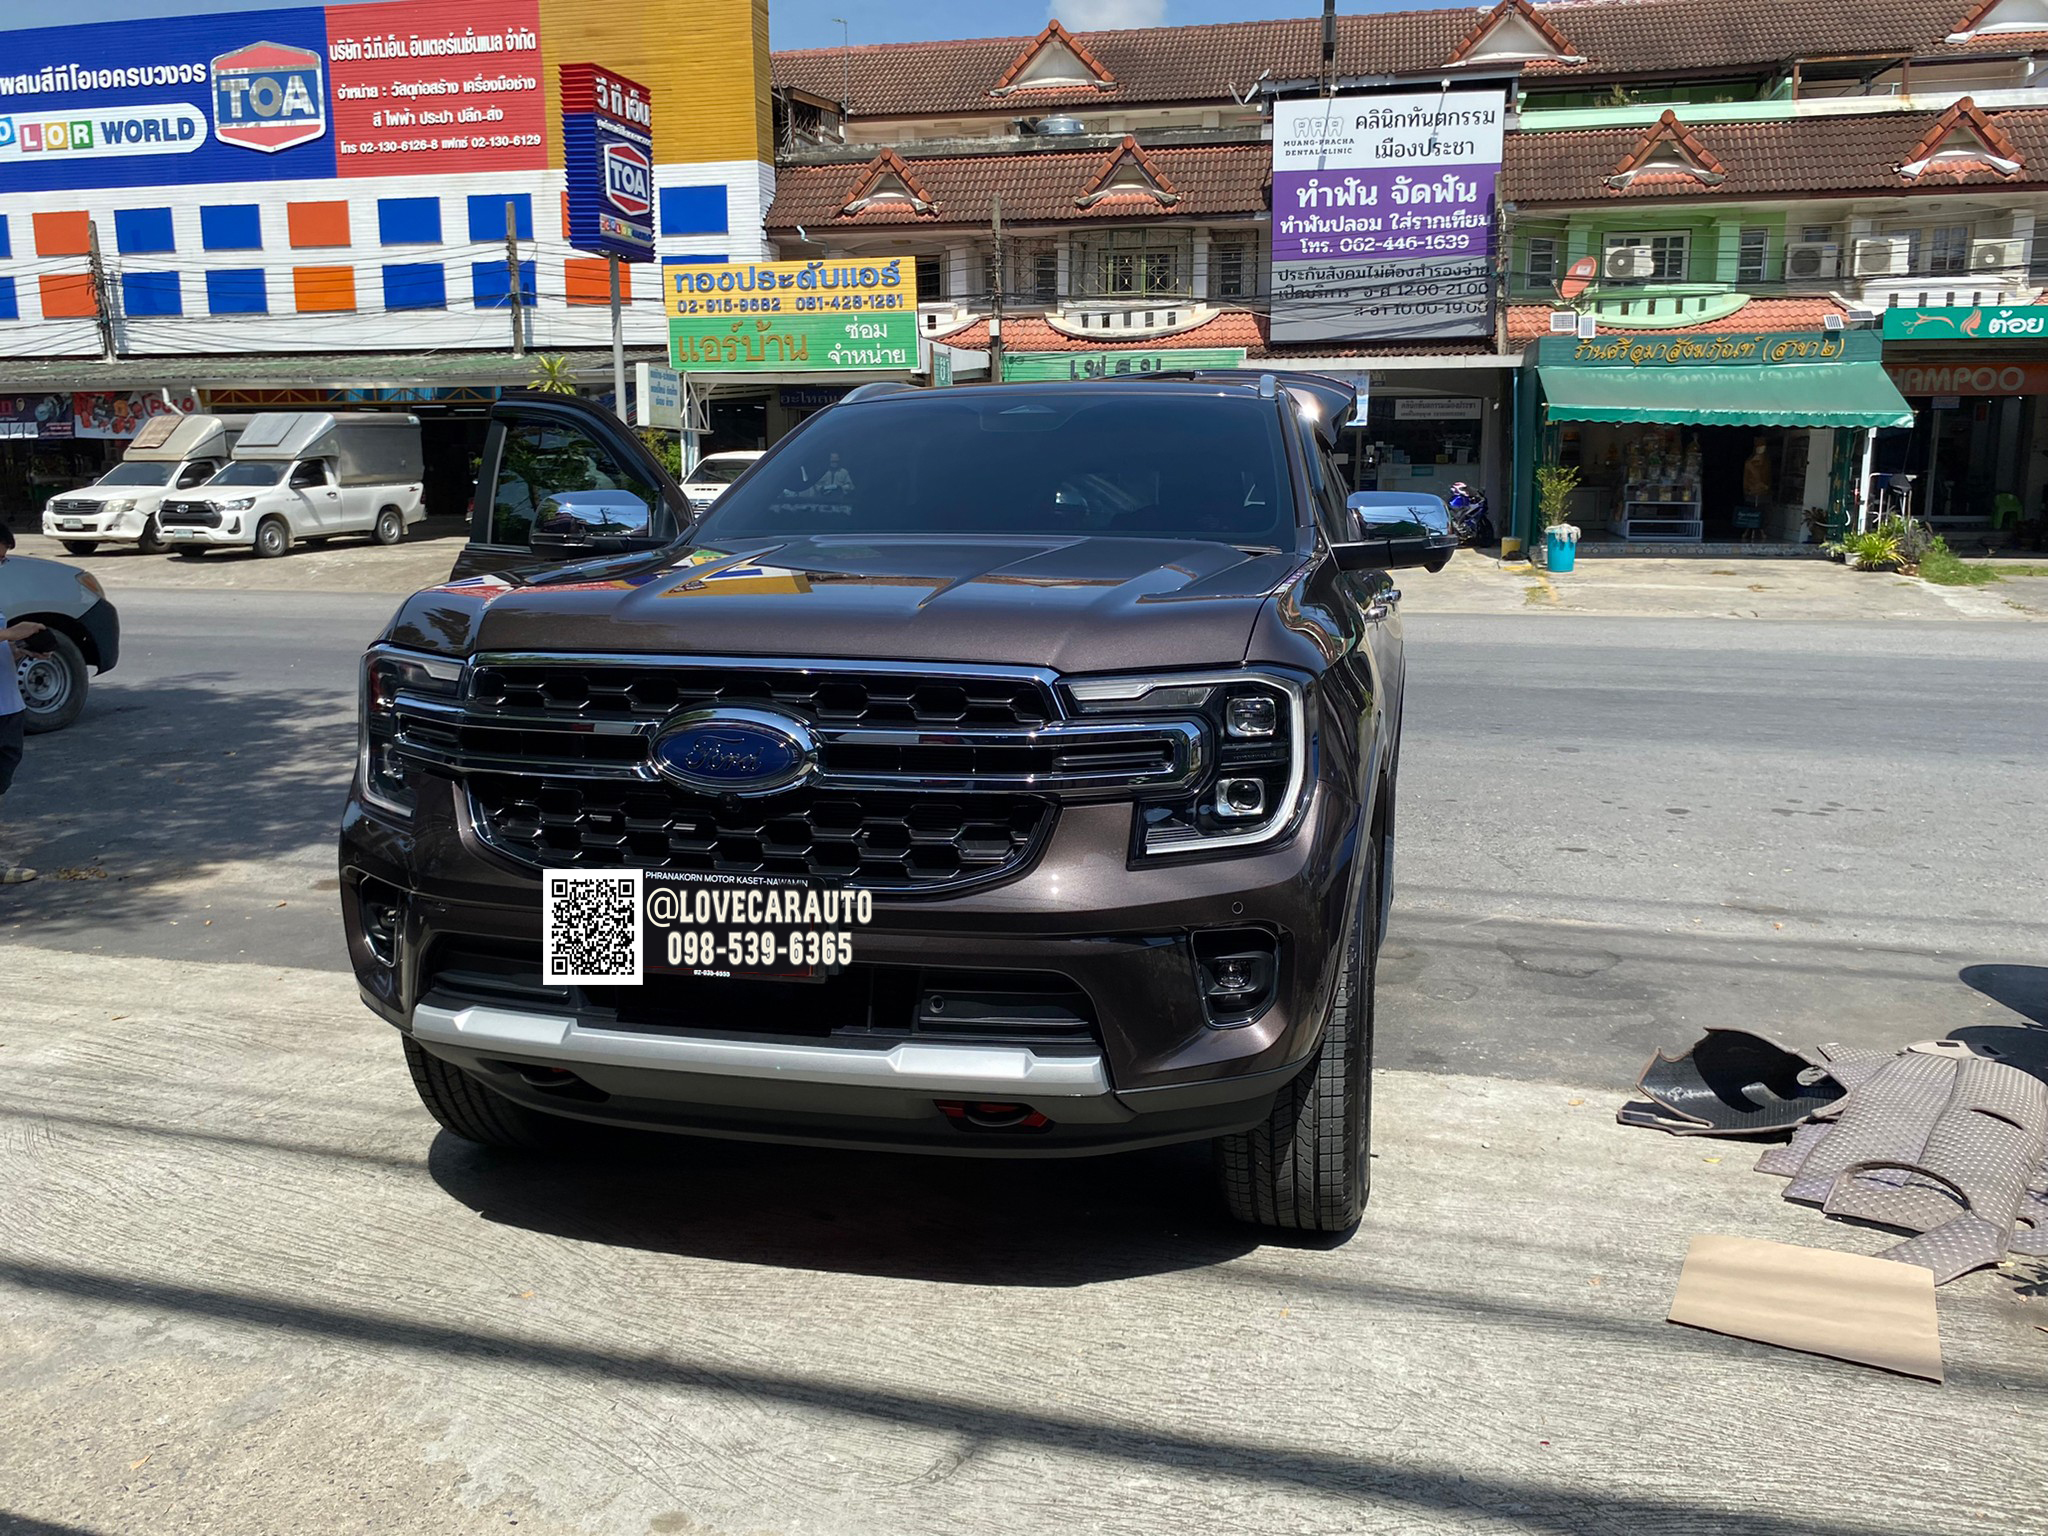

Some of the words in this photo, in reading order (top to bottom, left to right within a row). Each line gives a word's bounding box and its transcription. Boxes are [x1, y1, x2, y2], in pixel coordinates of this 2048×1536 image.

[329, 37, 361, 61] บริษัท
[410, 27, 503, 57] อินเตอร์เนชั่นแนล
[505, 26, 537, 51] จำกัด
[220, 75, 316, 119] TOA
[337, 83, 379, 100] จำหน่าย
[391, 79, 459, 101] วัสดุก่อสร้าง
[463, 73, 536, 93] เครื่องมือช่าง
[596, 76, 608, 110] วี
[611, 83, 623, 116] ที
[625, 89, 650, 127] เอ็น
[372, 112, 382, 128] สี
[384, 107, 416, 127] ไฟฟ้า
[419, 109, 453, 125] ประปา
[457, 105, 503, 123] ปลีก-ส่ง
[1355, 106, 1496, 131] คลินิกทันตกรรม
[101, 116, 195, 145] WORLD
[1283, 138, 1355, 147] MUANG-PRACHA
[340, 141, 357, 154] โทร
[359, 140, 438, 154] 02-130-6126-8
[441, 136, 468, 149] แฟกซ์
[471, 134, 542, 148] 02-130-6129
[1285, 149, 1320, 157] DENTAL
[1322, 147, 1353, 155] CLINIC
[1375, 137, 1475, 159] เมืองประชา
[611, 163, 647, 198] TOA
[1296, 176, 1378, 209] ทำฟัน
[1391, 174, 1478, 206] จัดฟัน
[1280, 215, 1382, 234] ทำฟันปลอม
[1389, 209, 1491, 231] ใส่รากเทียม
[1300, 238, 1334, 254] โทร.
[1339, 234, 1470, 253] 062-446-1639
[674, 259, 902, 293] ทองประดับแอร์
[1396, 282, 1489, 297] 12.00-21.00
[844, 316, 888, 339] ซ่อม
[1988, 309, 2045, 334] ต้อย
[677, 319, 809, 362] แอร์บ้าน
[827, 343, 906, 365] จำหน่าย
[685, 734, 764, 772] Ford
[645, 871, 703, 883] PHRANAKORN
[704, 874, 735, 884] MOTOR
